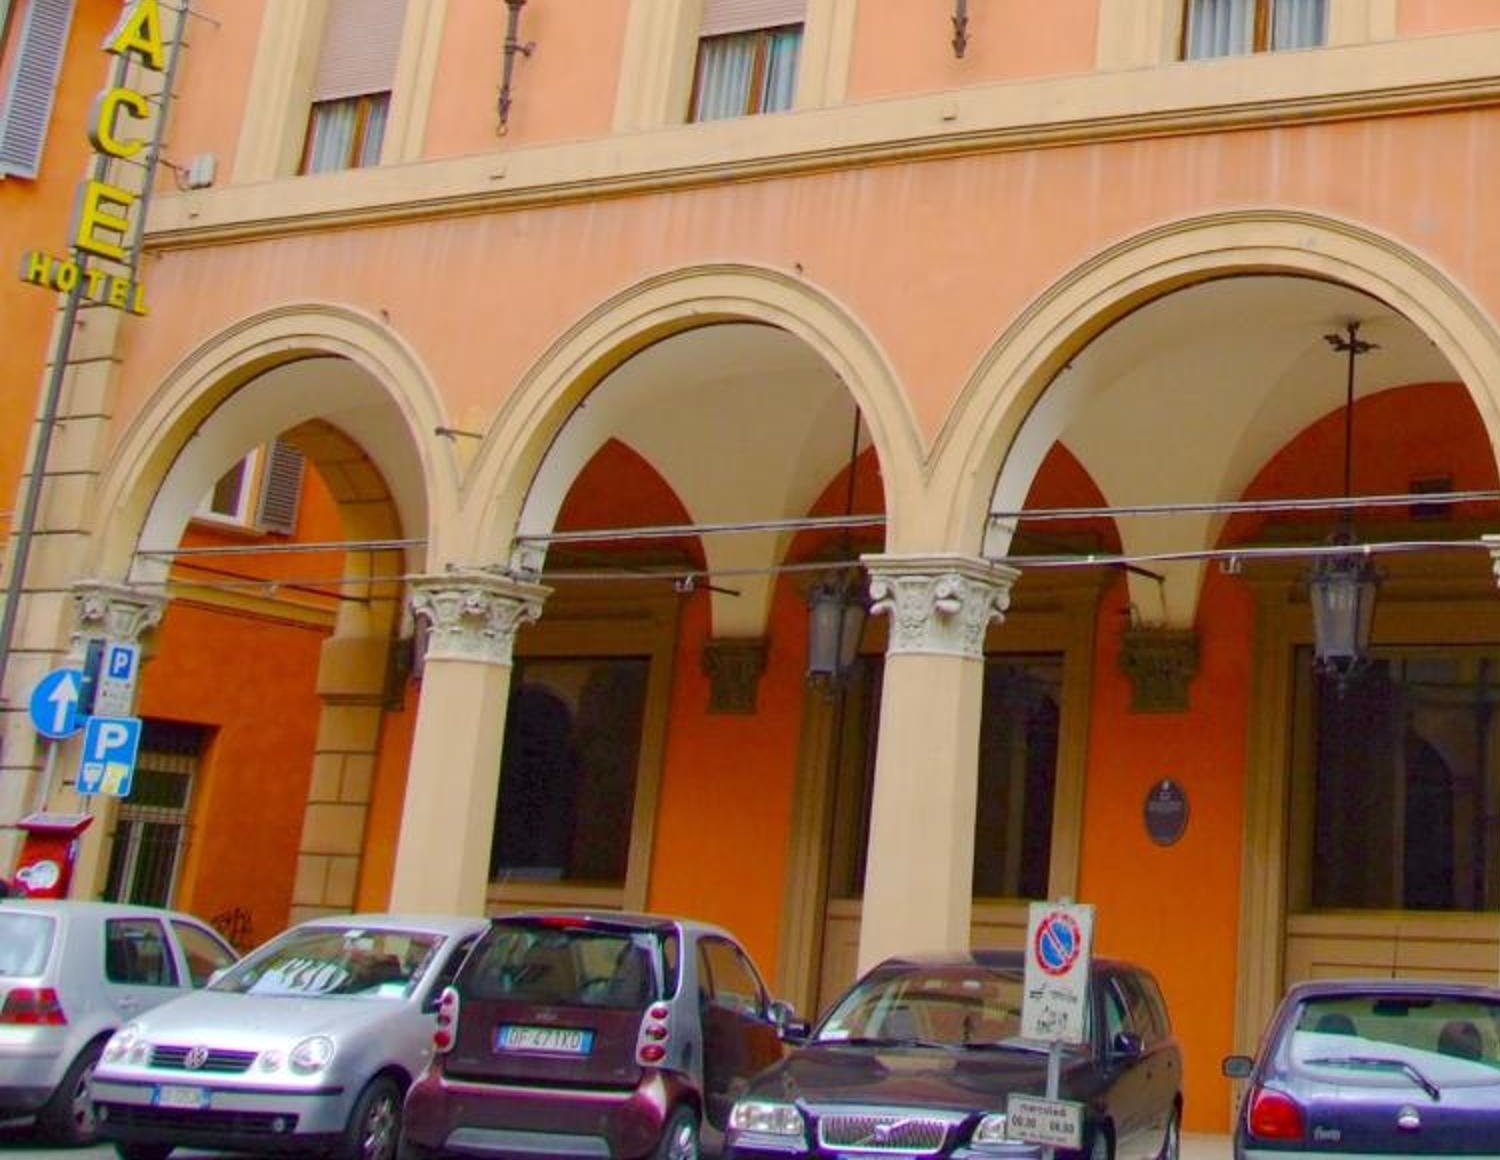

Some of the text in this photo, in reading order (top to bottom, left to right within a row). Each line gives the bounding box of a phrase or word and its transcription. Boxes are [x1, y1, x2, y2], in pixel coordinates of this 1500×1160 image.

[22, 250, 150, 315] HOTEL
[113, 650, 129, 675] P
[94, 722, 129, 760] P
